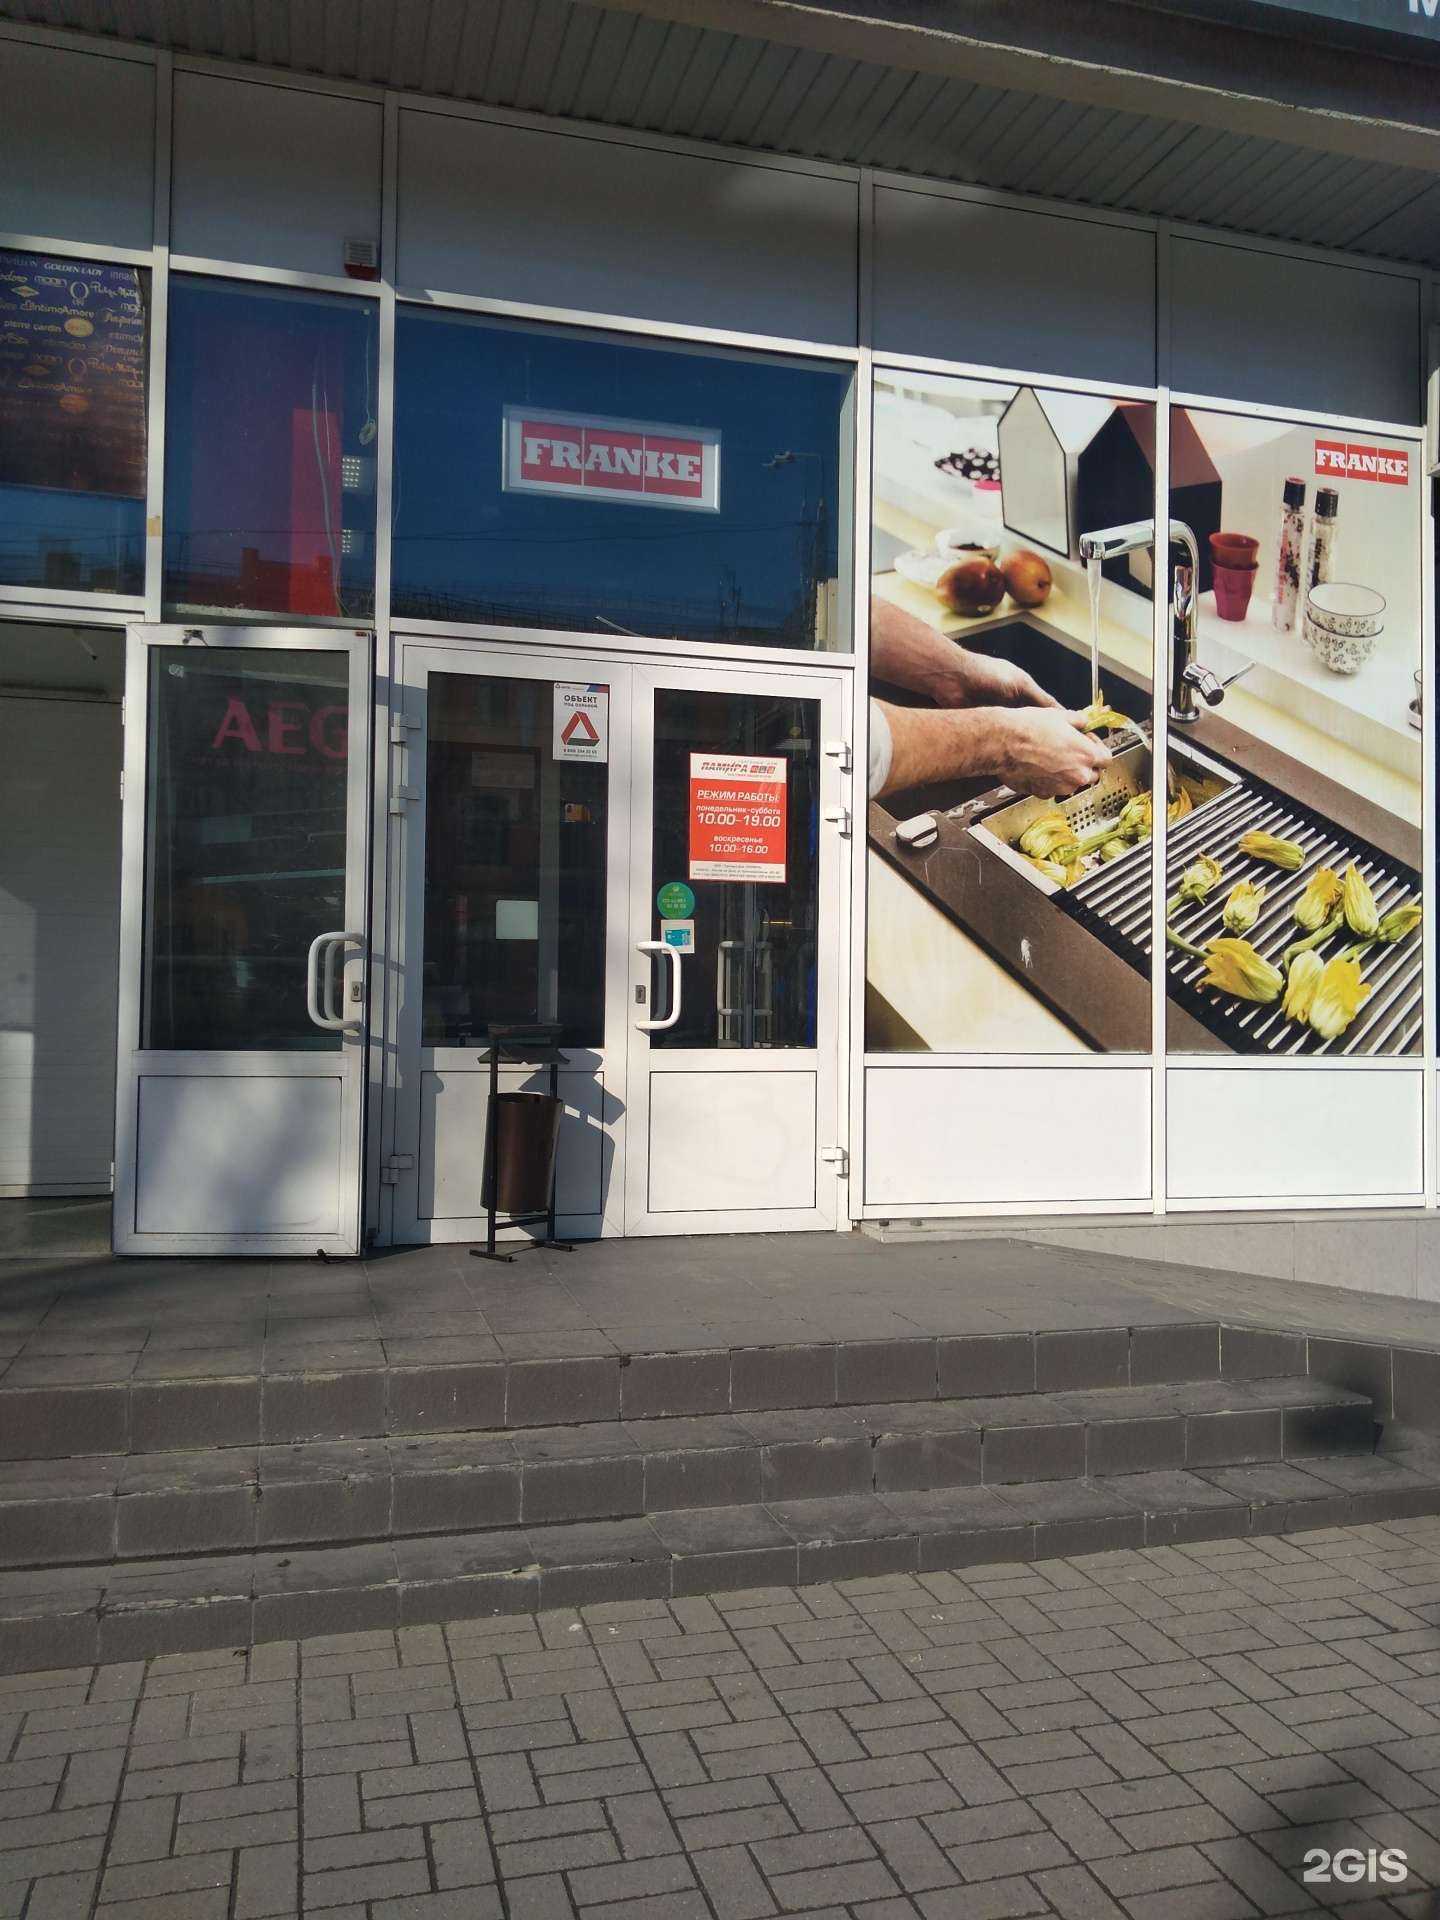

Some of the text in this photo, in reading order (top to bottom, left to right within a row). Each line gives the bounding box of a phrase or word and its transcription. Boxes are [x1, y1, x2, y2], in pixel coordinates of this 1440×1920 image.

[43, 262, 80, 273] GOLDEN
[81, 267, 104, 277] LADY
[524, 437, 701, 482] FRANKE
[1316, 449, 1408, 477] FRANKE
[564, 694, 598, 704] ОБЪЕКТ
[211, 695, 349, 758] AEG
[697, 789, 736, 800] РЕЖИМ
[713, 835, 763, 843] воскресенье
